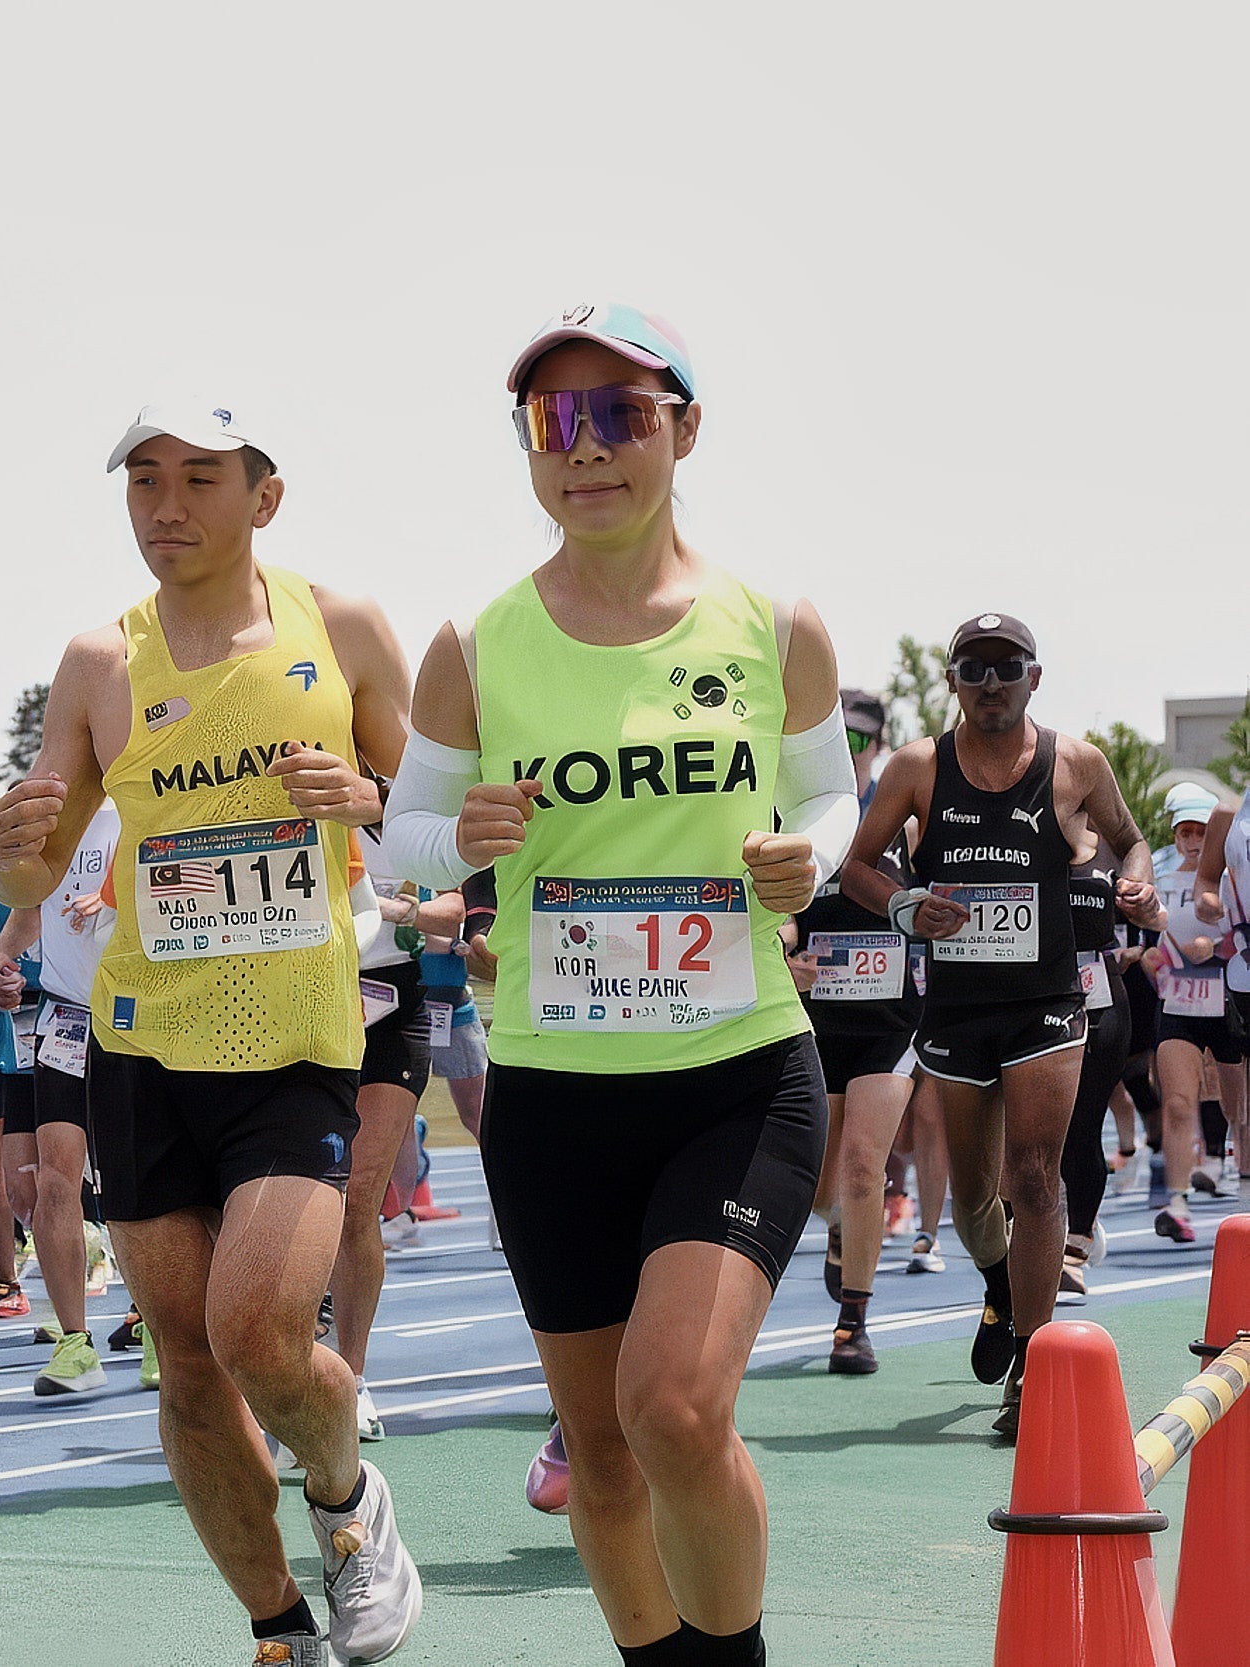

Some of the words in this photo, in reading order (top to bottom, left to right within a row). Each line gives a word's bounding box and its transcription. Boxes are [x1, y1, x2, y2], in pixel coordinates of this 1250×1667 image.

[513, 740, 757, 808] KOREA
[214, 850, 317, 906] 114
[636, 914, 713, 972] 12
[973, 904, 1033, 932] 120
